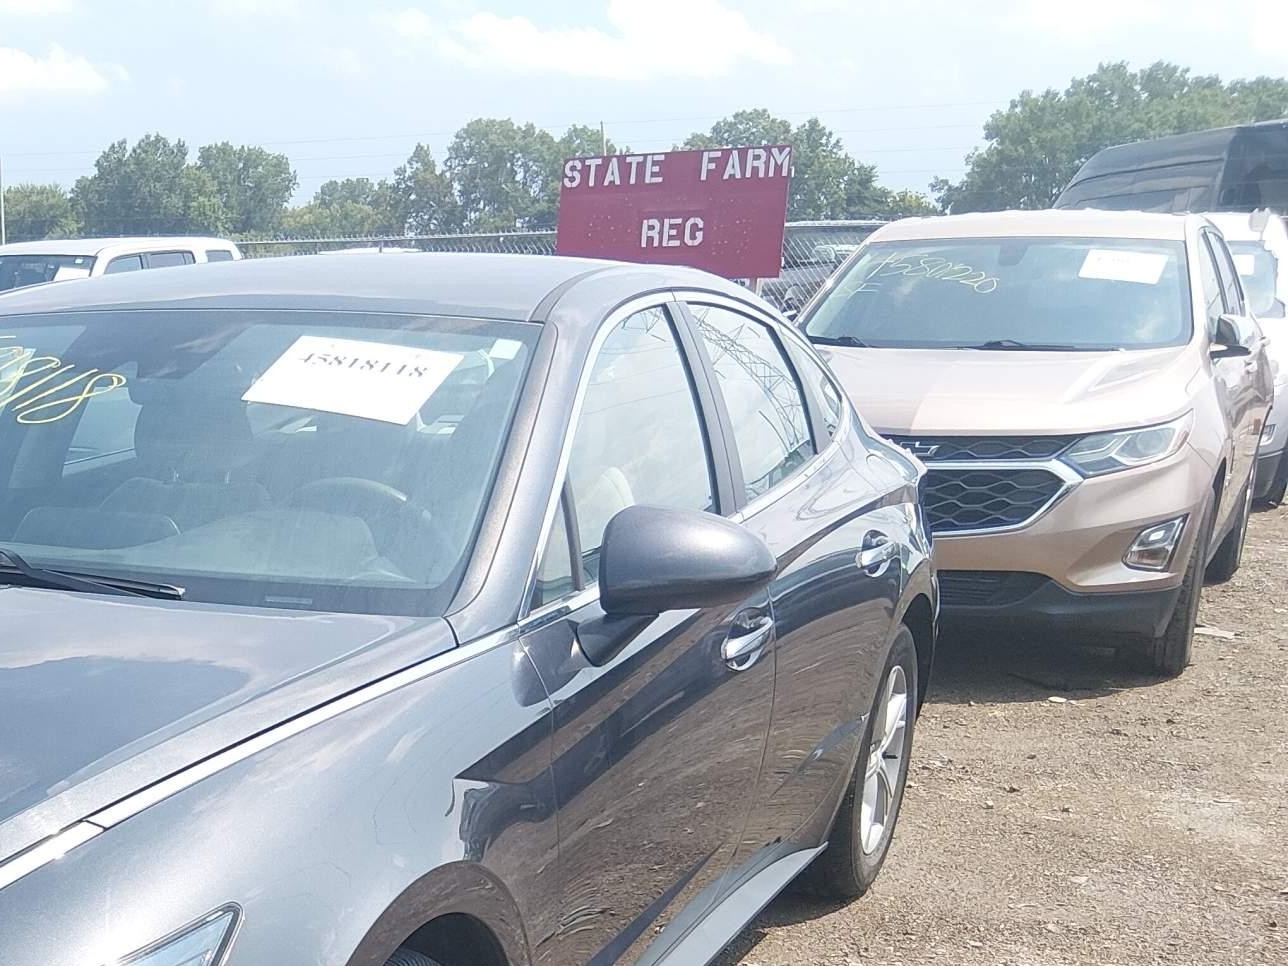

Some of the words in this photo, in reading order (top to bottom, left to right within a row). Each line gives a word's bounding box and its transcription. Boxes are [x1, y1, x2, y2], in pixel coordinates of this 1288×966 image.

[562, 154, 666, 189] STATE
[699, 146, 791, 182] FARM
[640, 216, 705, 249] REG
[298, 352, 429, 378] 45818118
